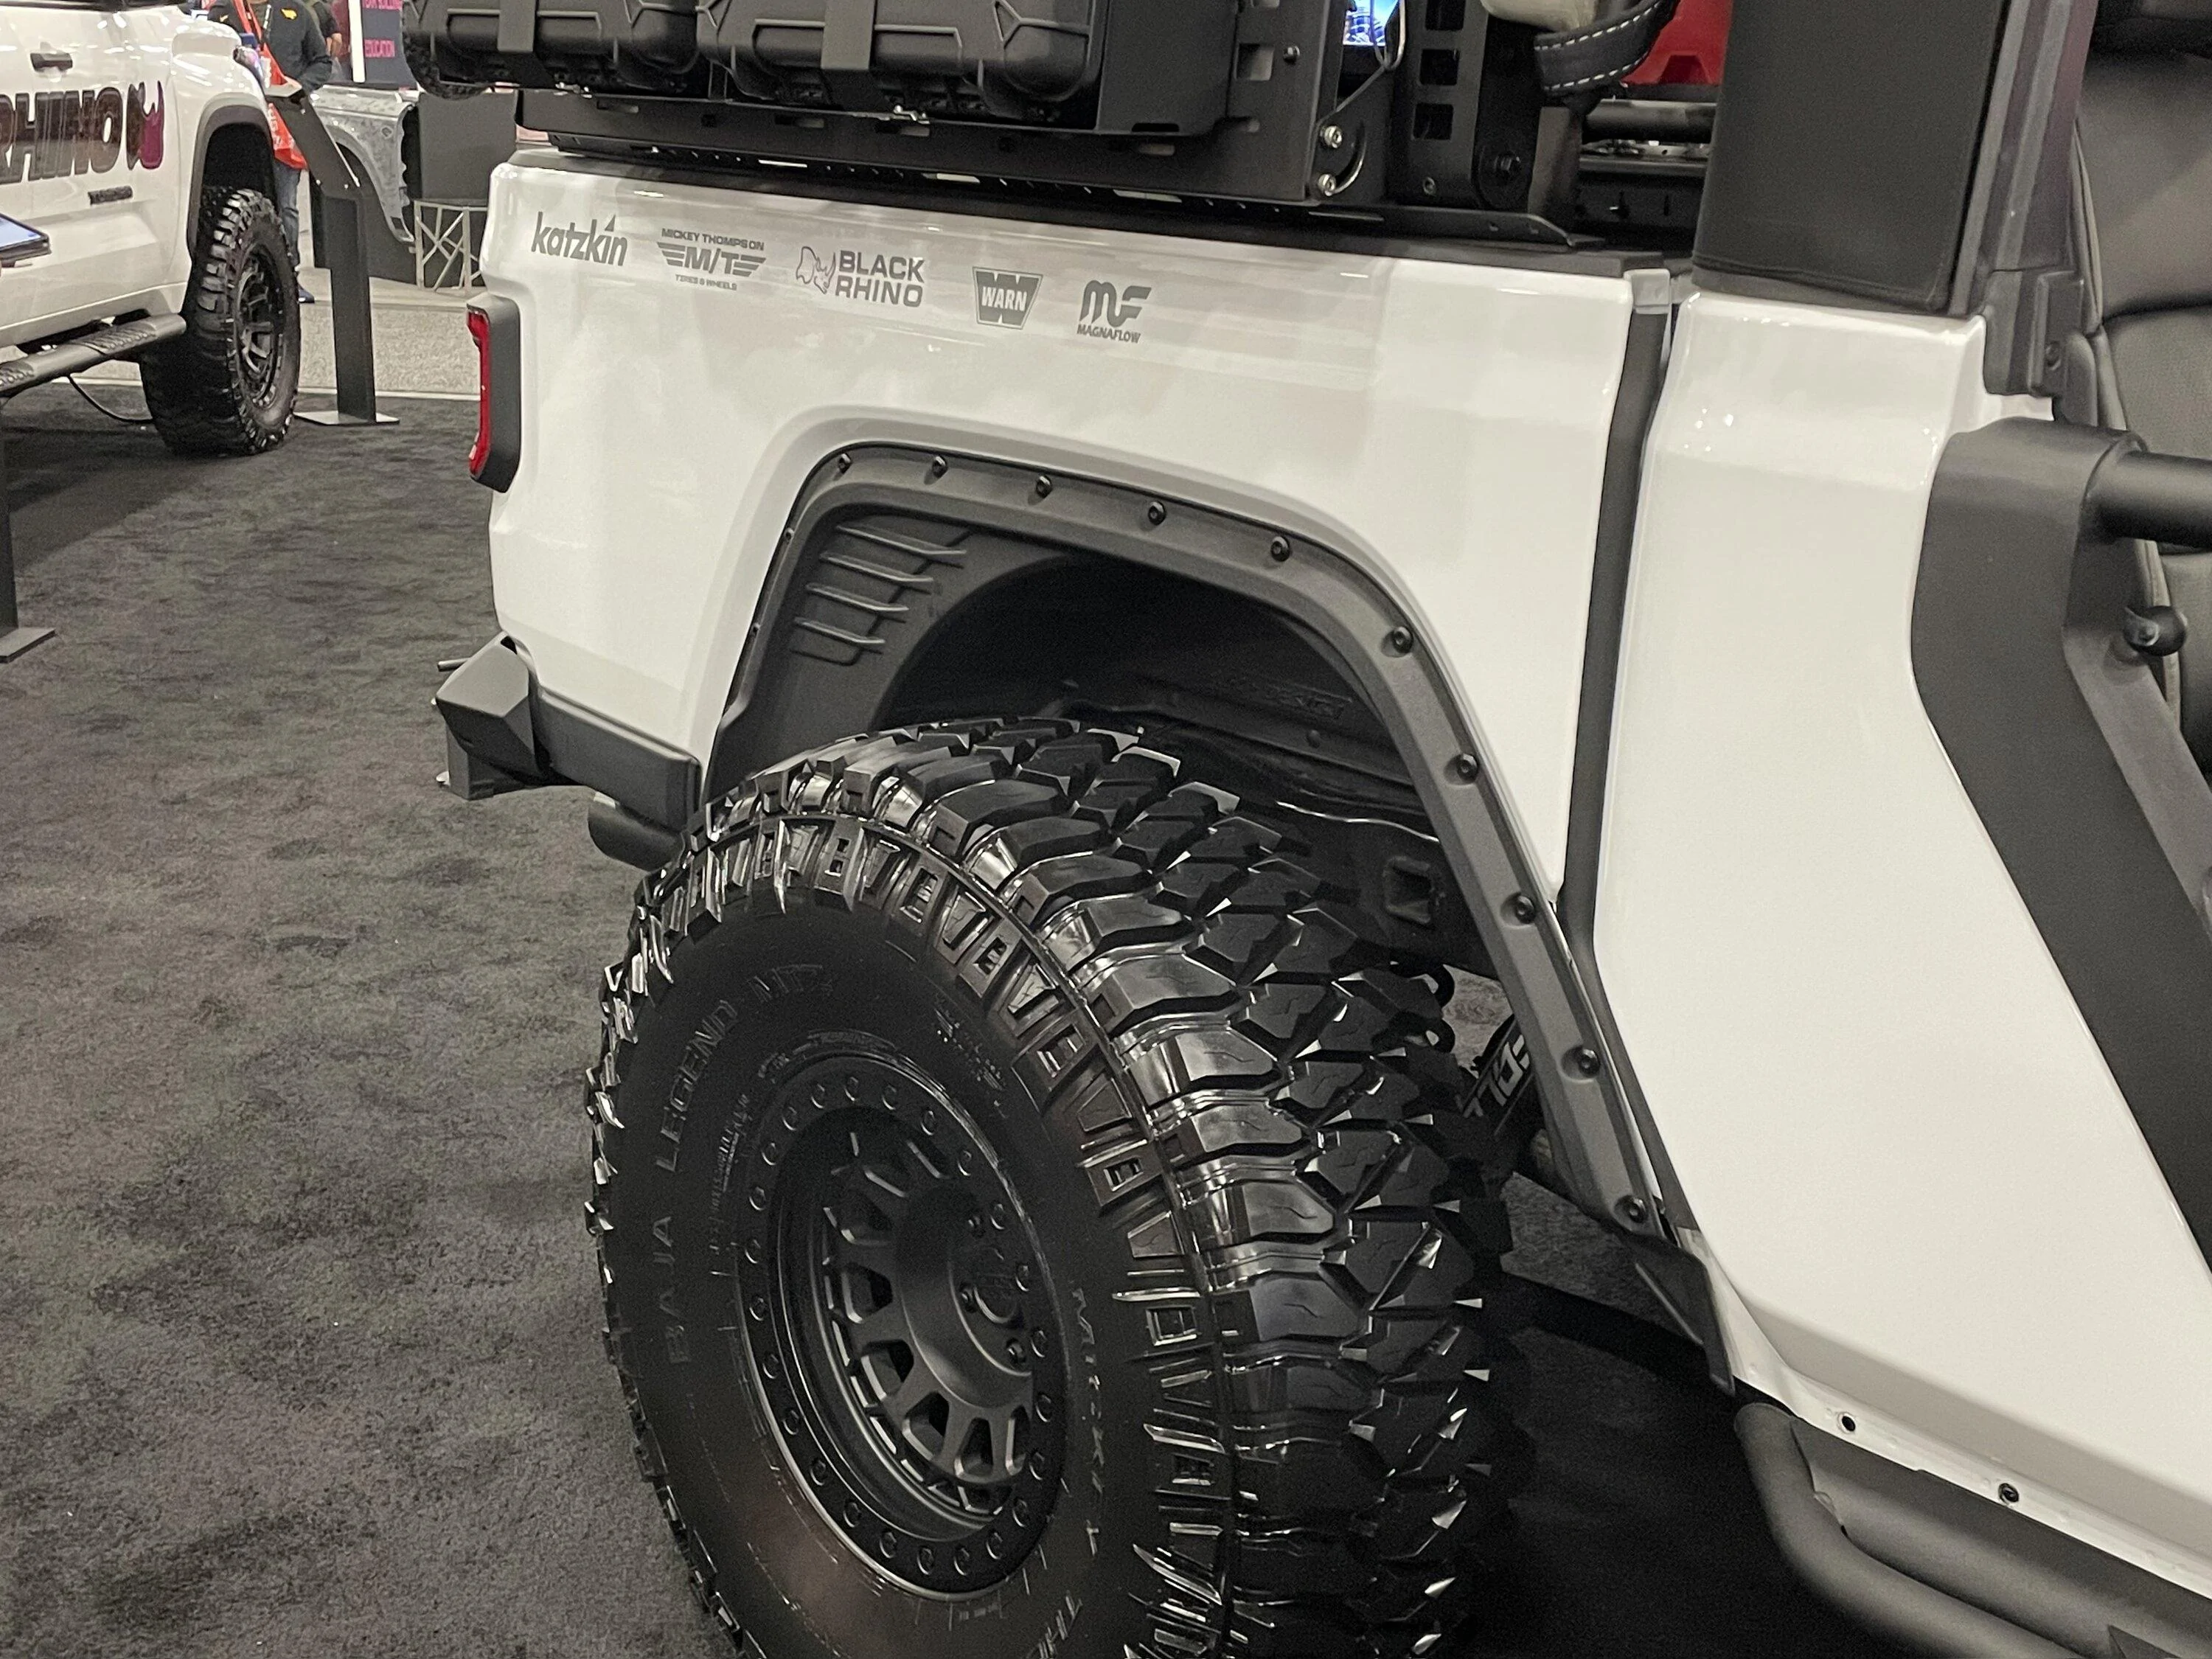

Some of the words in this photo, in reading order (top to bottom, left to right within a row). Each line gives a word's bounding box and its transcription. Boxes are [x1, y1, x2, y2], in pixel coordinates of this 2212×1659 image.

[531, 211, 627, 266] katzkin
[661, 228, 700, 242] MICKEY
[702, 233, 765, 251] THOMPSON
[839, 250, 925, 283] BLACK
[835, 276, 924, 307] RHINO
[981, 285, 1028, 311] WARN
[1077, 324, 1141, 344] MAGNAFLOW
[655, 1000, 737, 1172] LEGEND
